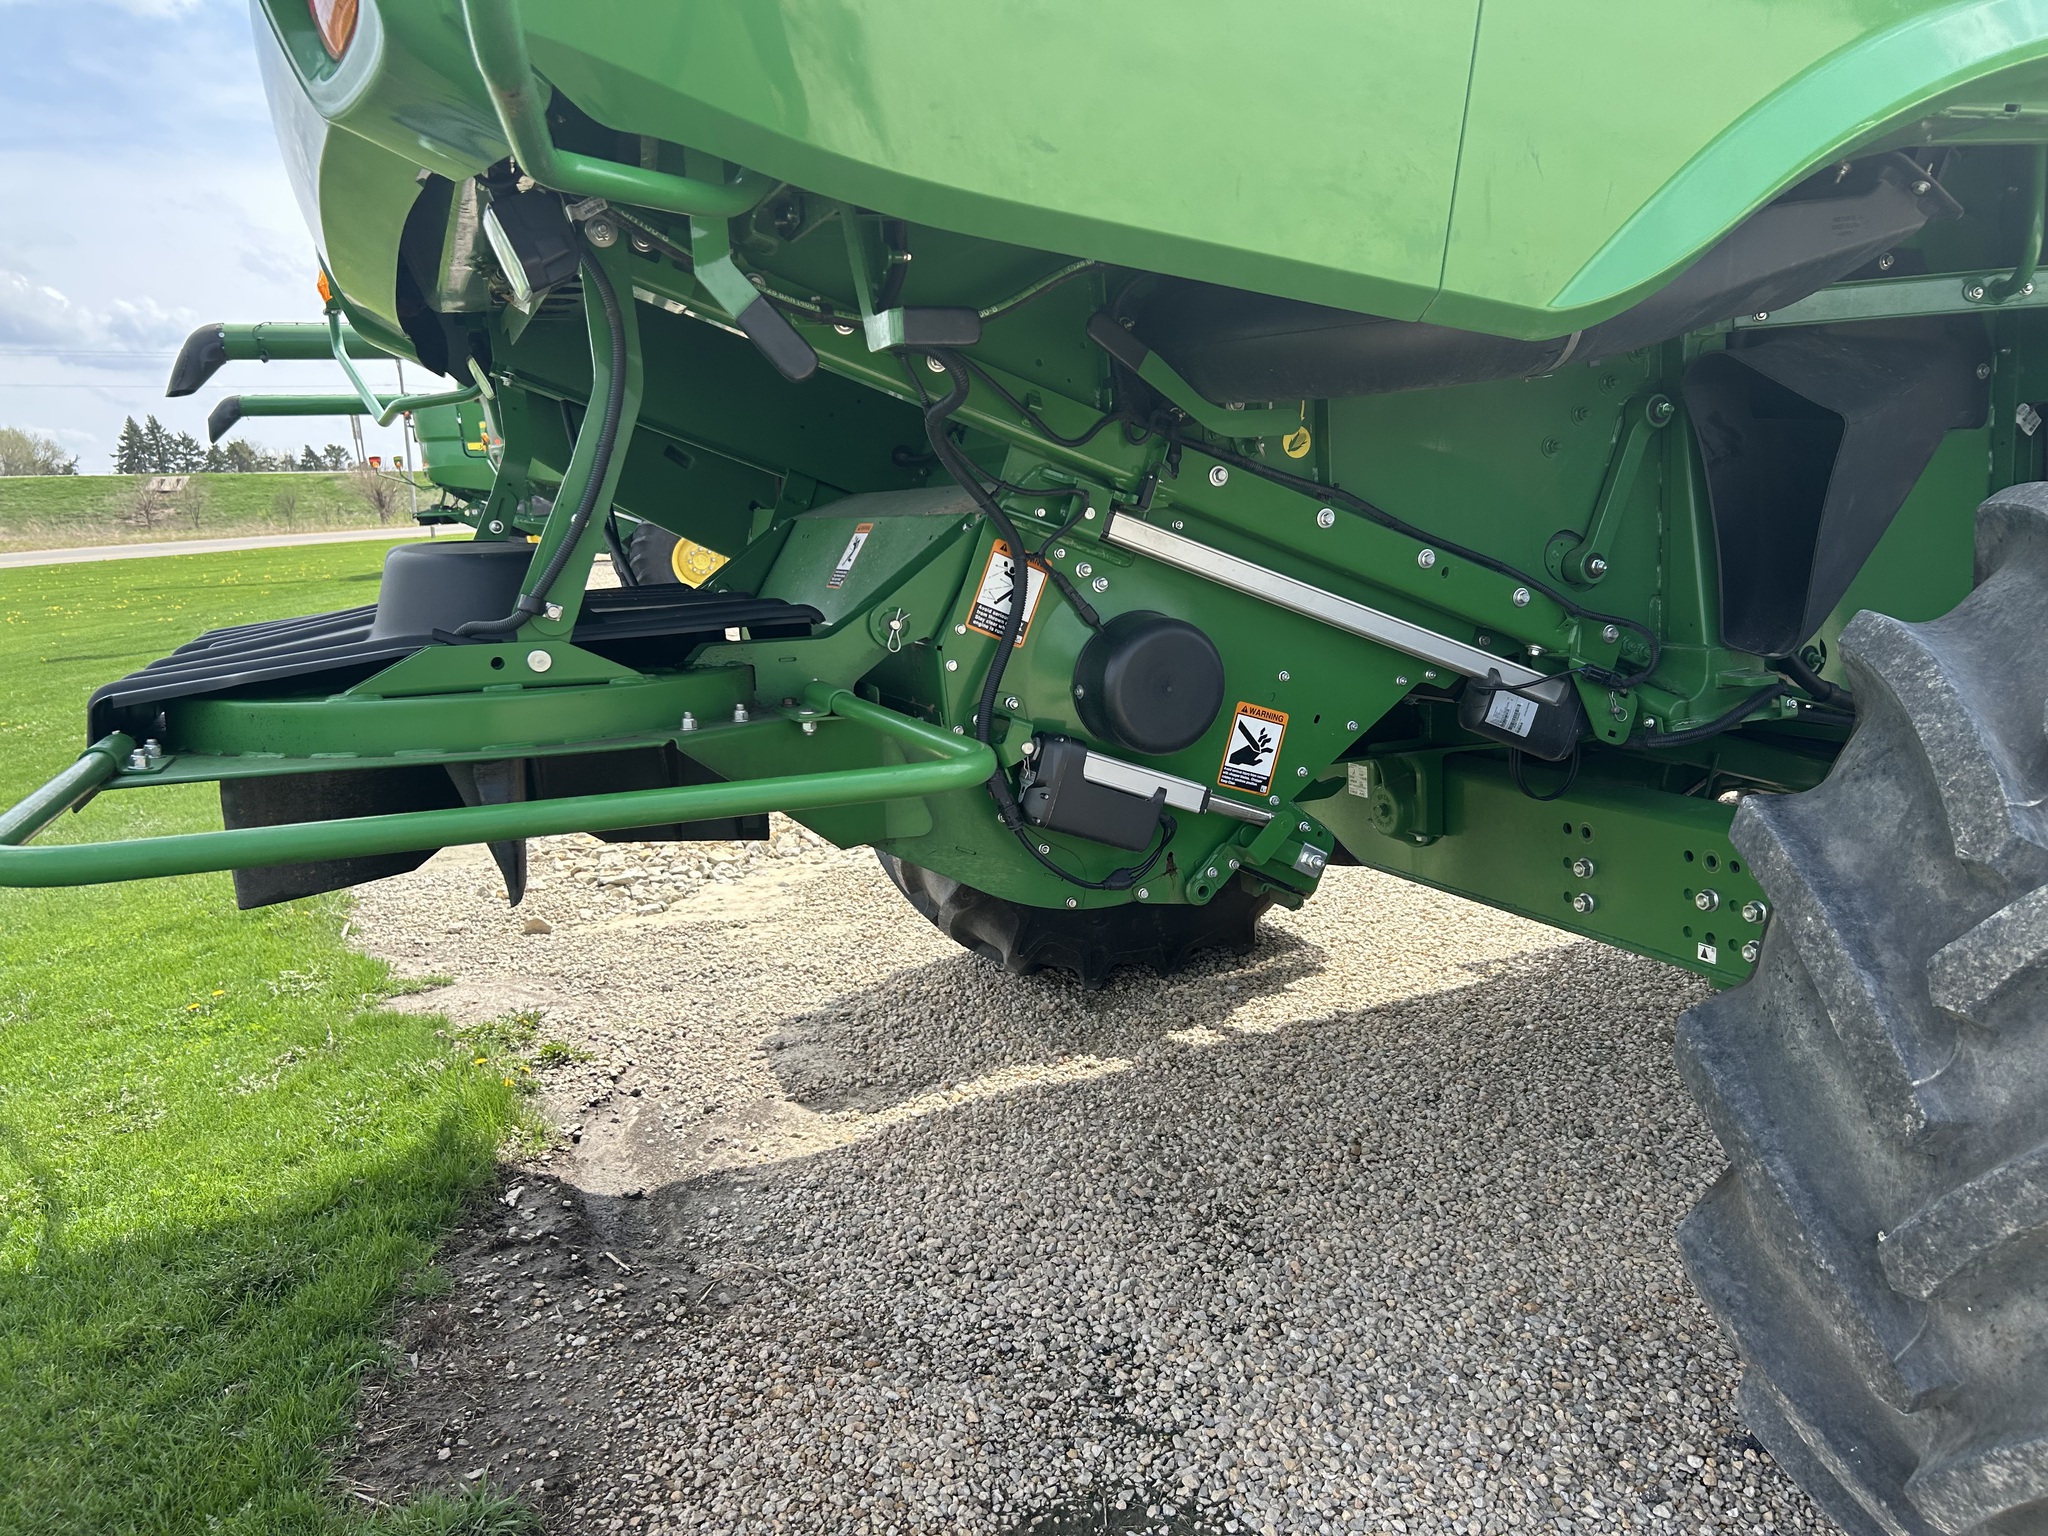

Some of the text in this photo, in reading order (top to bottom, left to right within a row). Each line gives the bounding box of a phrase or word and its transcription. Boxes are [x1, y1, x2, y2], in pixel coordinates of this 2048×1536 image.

[976, 610, 988, 618] from
[988, 614, 1005, 624] thrown
[978, 605, 1009, 620] Avoid seriou
[972, 619, 989, 630] engine
[974, 614, 986, 623] Stay
[985, 619, 998, 627] clear
[1249, 706, 1284, 723] WARNING
